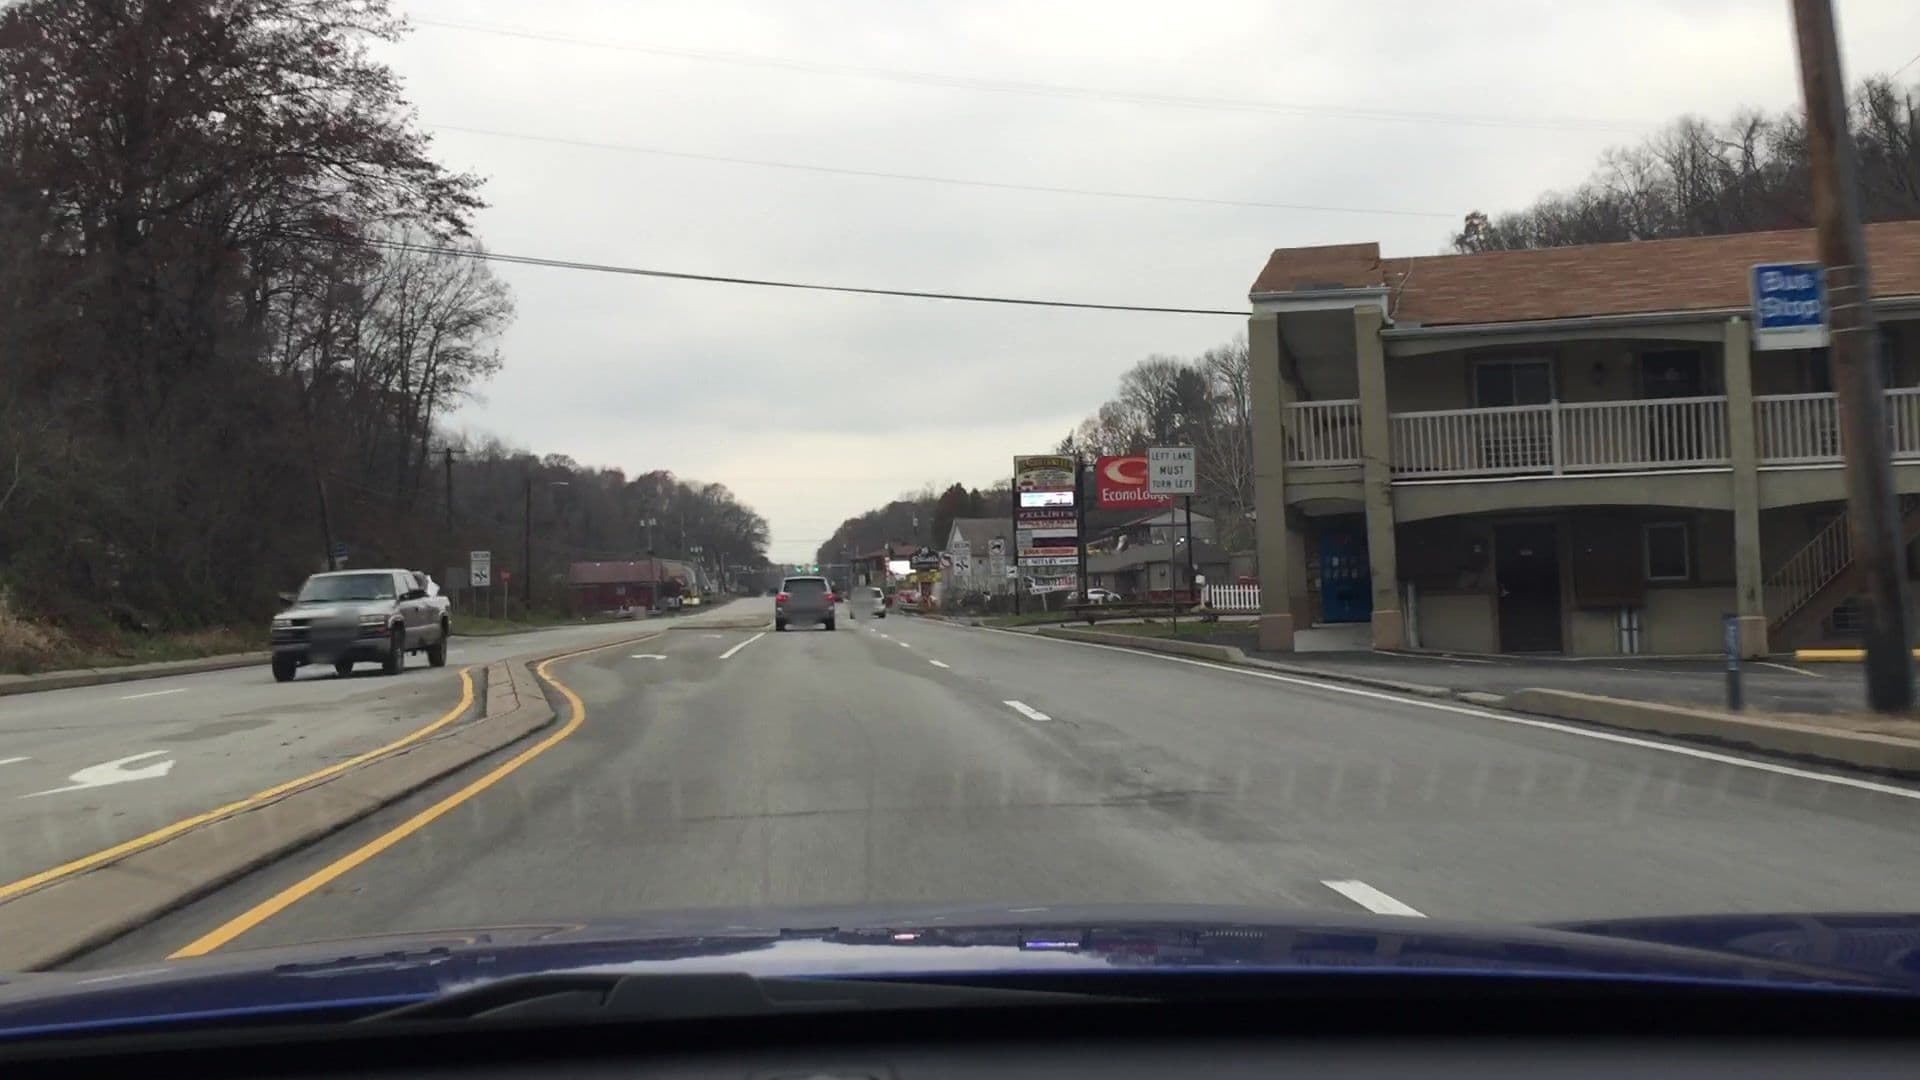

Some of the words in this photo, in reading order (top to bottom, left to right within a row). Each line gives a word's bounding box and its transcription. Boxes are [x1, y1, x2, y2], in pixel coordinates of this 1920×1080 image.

[1761, 271, 1814, 292] Bus
[1760, 297, 1820, 320] Stop
[1151, 452, 1169, 461] LEFT
[1173, 452, 1193, 461] LANE
[1160, 465, 1185, 475] MUST
[1152, 480, 1172, 489] TURN
[1175, 480, 1193, 489] LEFT
